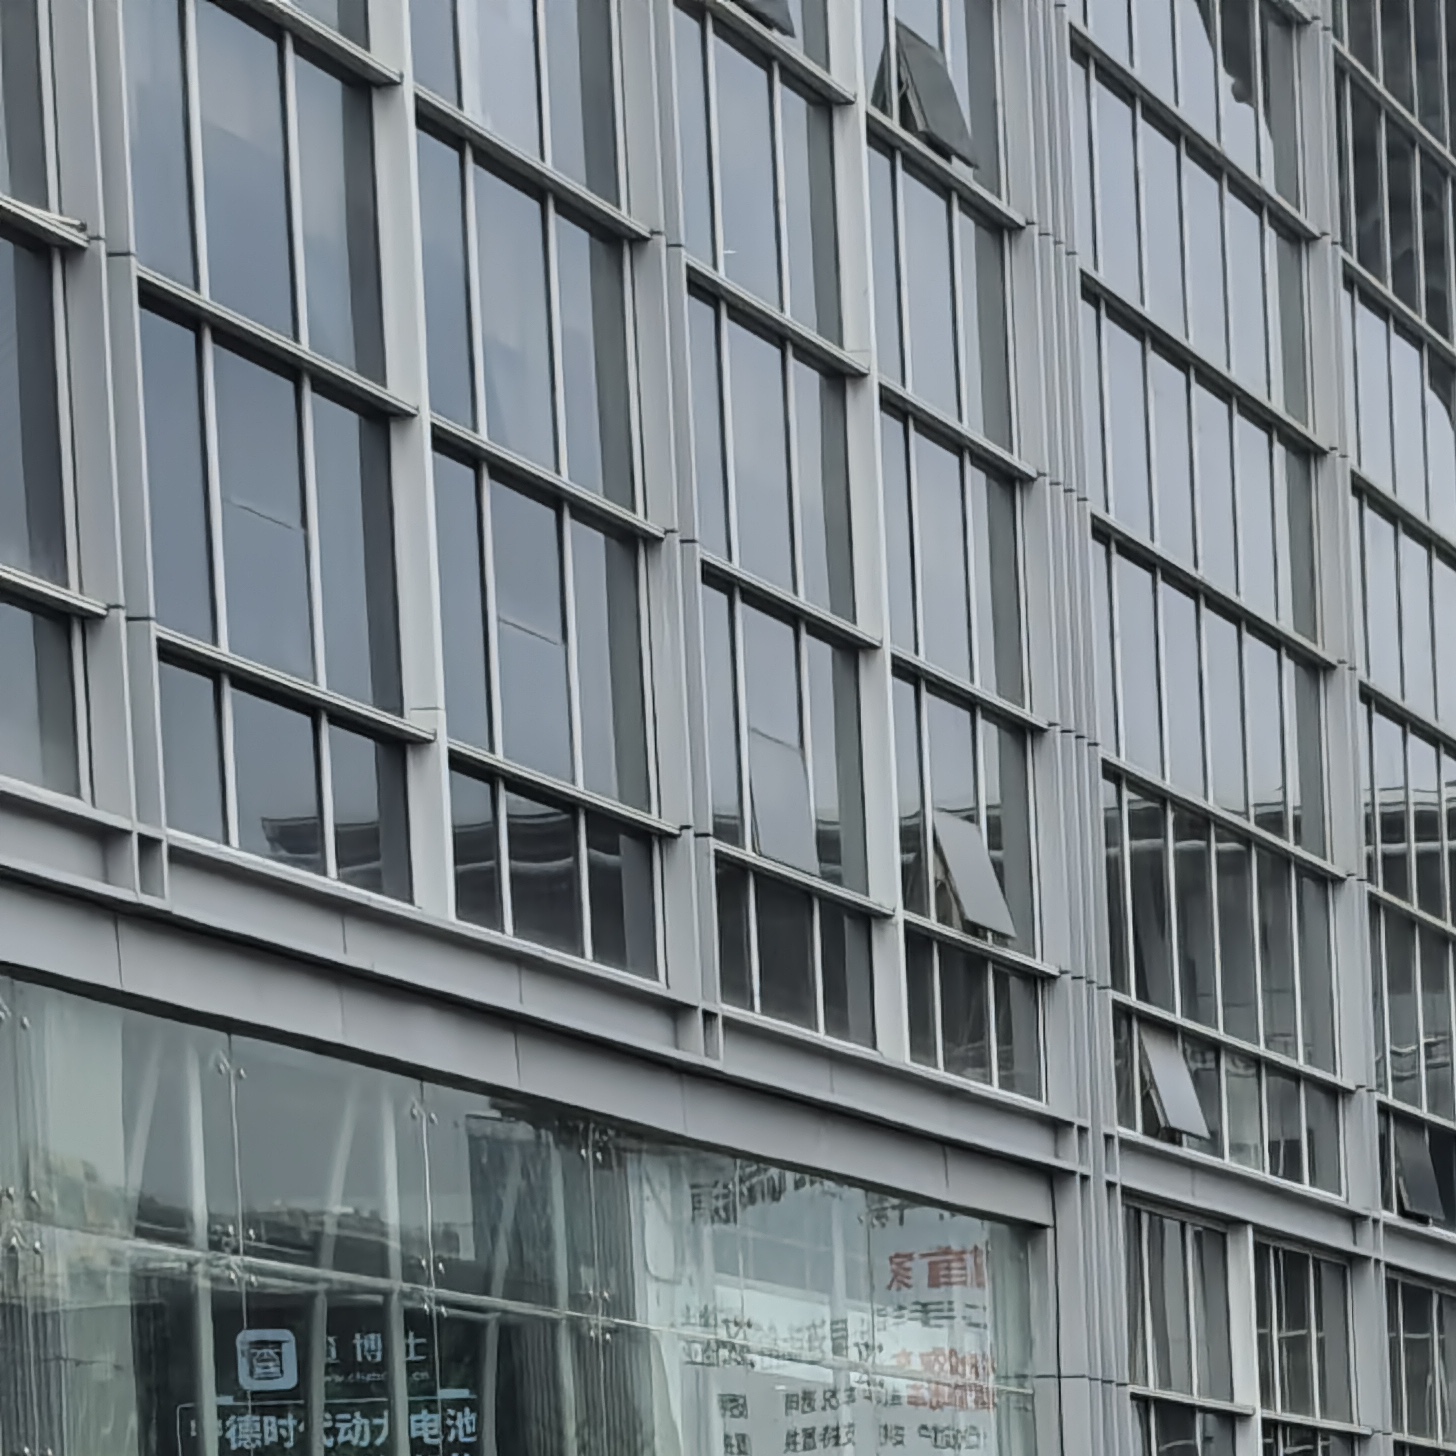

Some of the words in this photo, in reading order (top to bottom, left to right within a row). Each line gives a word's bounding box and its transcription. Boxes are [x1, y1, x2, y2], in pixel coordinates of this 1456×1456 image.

[189, 1406, 478, 1450] 德时动电池
